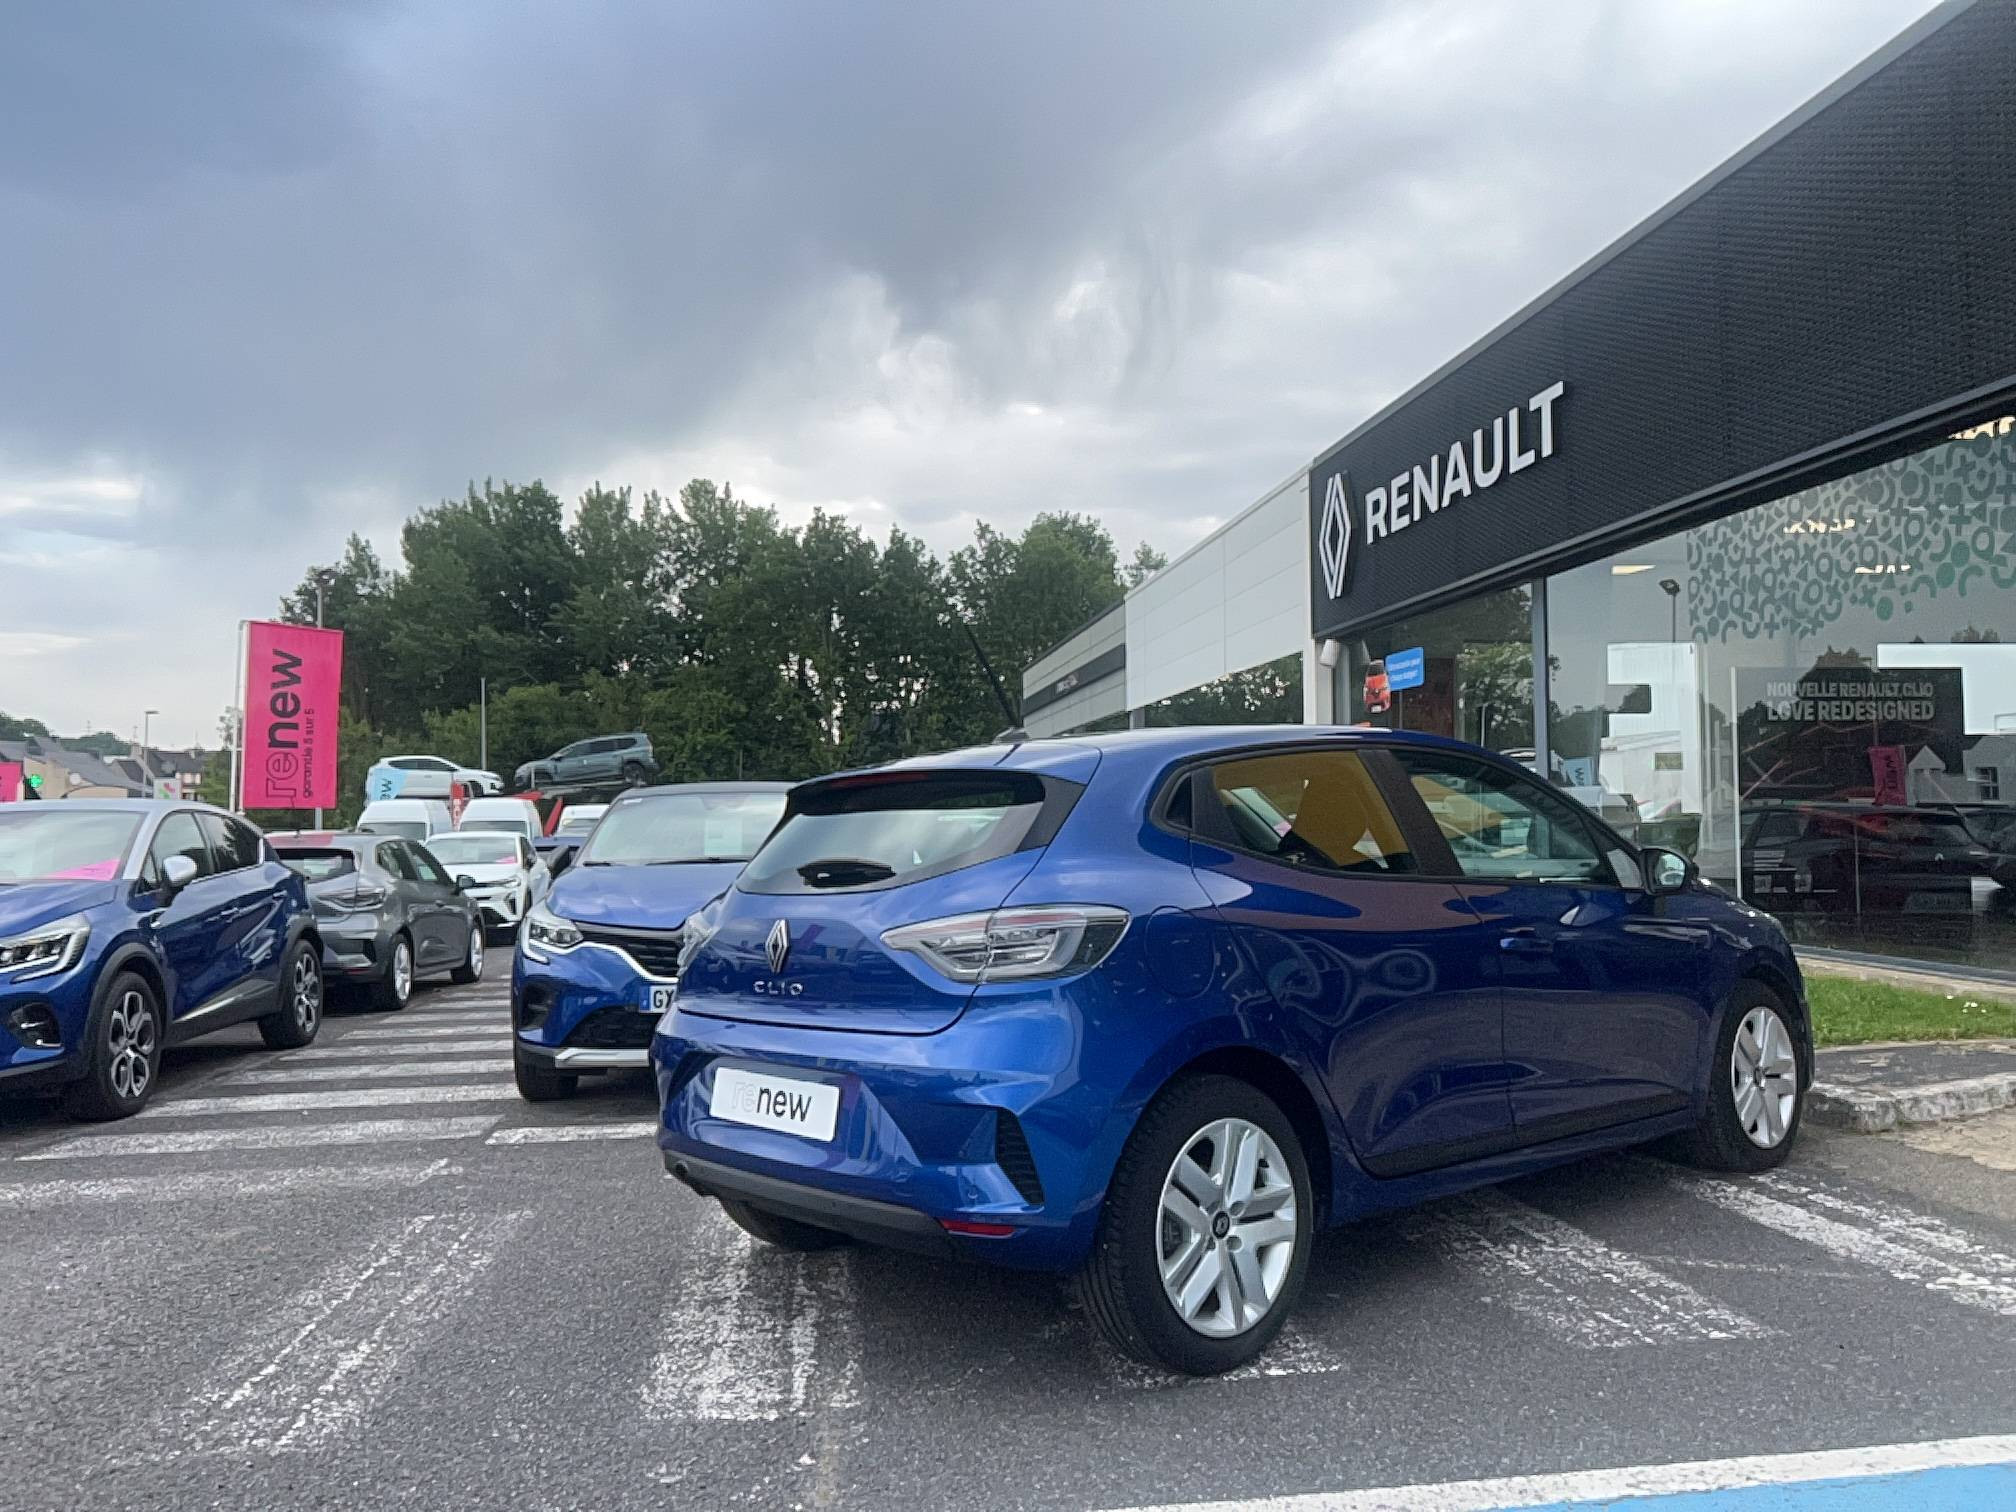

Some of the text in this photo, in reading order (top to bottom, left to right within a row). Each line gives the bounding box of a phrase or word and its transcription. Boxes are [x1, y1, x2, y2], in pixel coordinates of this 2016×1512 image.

[1365, 380, 1564, 545] RENAULT
[1767, 681, 1934, 697] NOUVELLE RENAULT CLIO
[1768, 701, 1935, 721] LOVE REDESIGNED
[266, 649, 303, 798] renew
[304, 716, 315, 735] sur
[753, 980, 803, 996] CLIO
